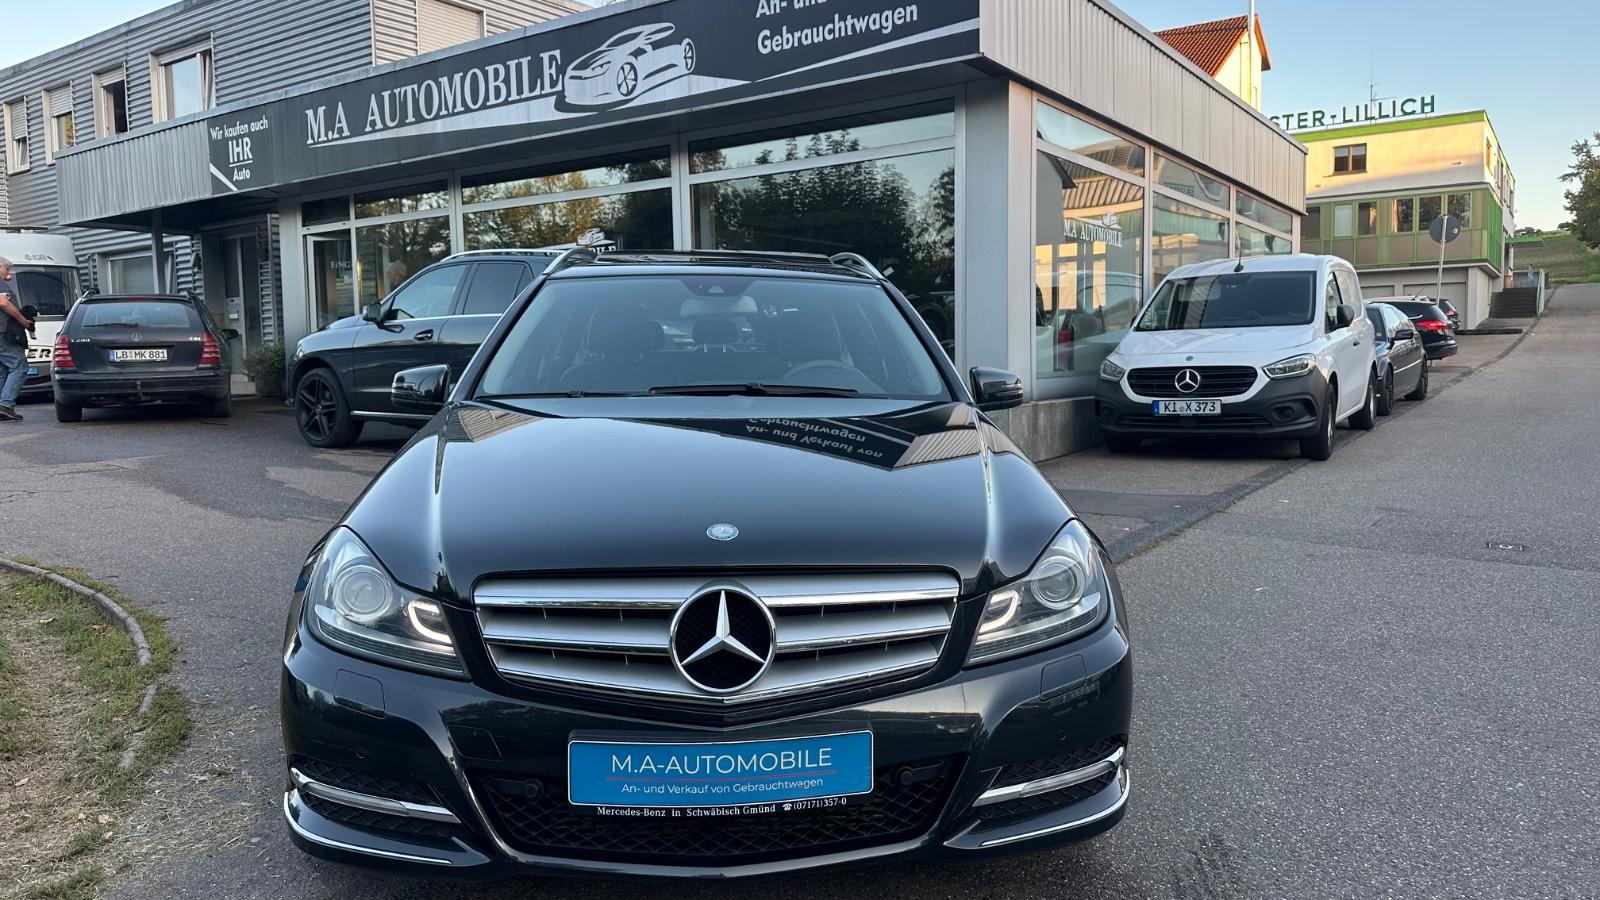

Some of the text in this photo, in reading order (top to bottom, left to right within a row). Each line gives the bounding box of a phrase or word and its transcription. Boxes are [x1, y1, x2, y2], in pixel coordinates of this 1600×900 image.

[755, 0, 788, 18] An-
[757, 4, 918, 54] Gebrauchtwagen
[305, 49, 563, 145] M.A AUTOMOBILE
[210, 114, 269, 141] Wir kaufen auch
[228, 137, 253, 163] IHR
[233, 167, 251, 181] Auto
[1080, 221, 1123, 248] AUTOMOBILE
[115, 350, 167, 359] LB MK 881
[1164, 401, 1216, 412] KI X 373
[611, 748, 832, 775] M.A-AUTOMOBILE
[621, 779, 823, 794] An- und Verkauf von Gebrauchtwagen
[597, 806, 666, 817] Mercedes-Benz
[671, 808, 681, 817] in
[686, 806, 740, 817] Schwäbisch
[742, 804, 776, 815] Gmünd
